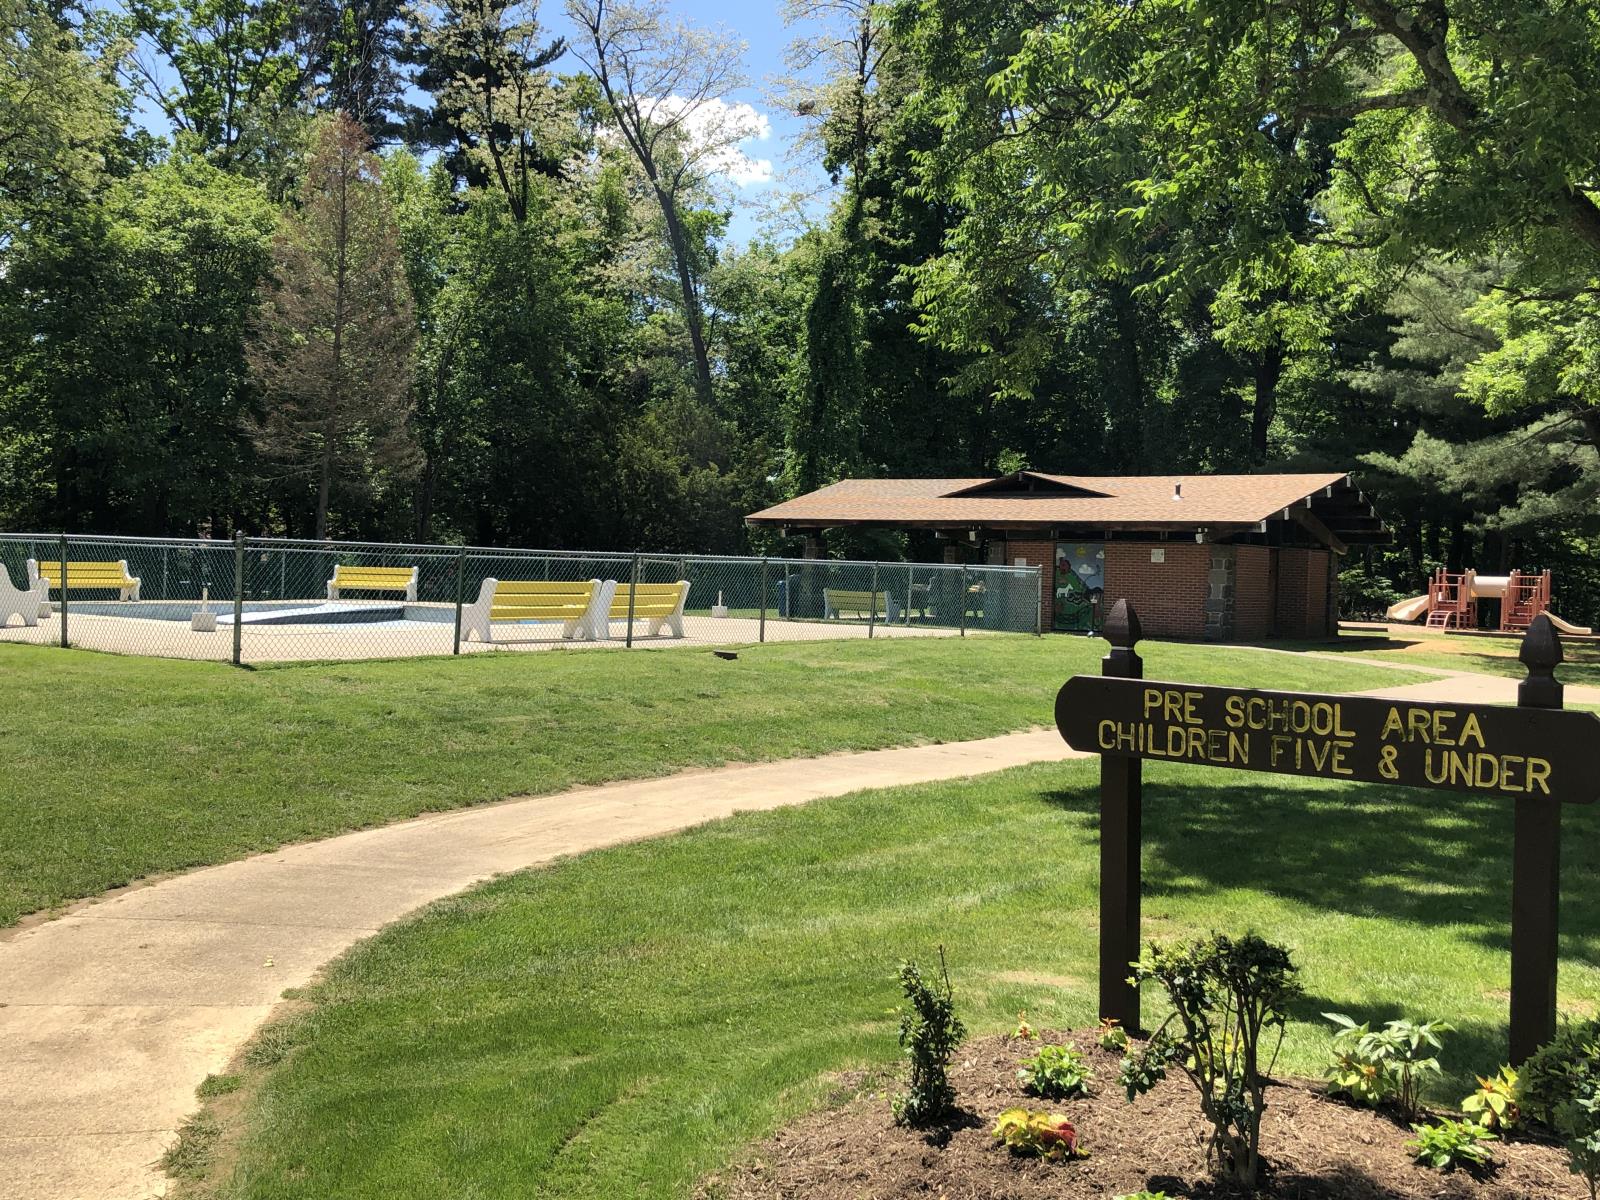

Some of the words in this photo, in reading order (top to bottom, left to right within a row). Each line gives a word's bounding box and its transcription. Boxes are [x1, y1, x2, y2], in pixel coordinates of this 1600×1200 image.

[1144, 688, 1204, 725] PRE
[1225, 696, 1356, 738] SCHOOL
[1381, 706, 1486, 748] AREA
[1098, 719, 1249, 765] CHILDREN
[1270, 735, 1354, 775] FIVE
[1378, 745, 1399, 780] &
[1424, 749, 1552, 795] UNDER
